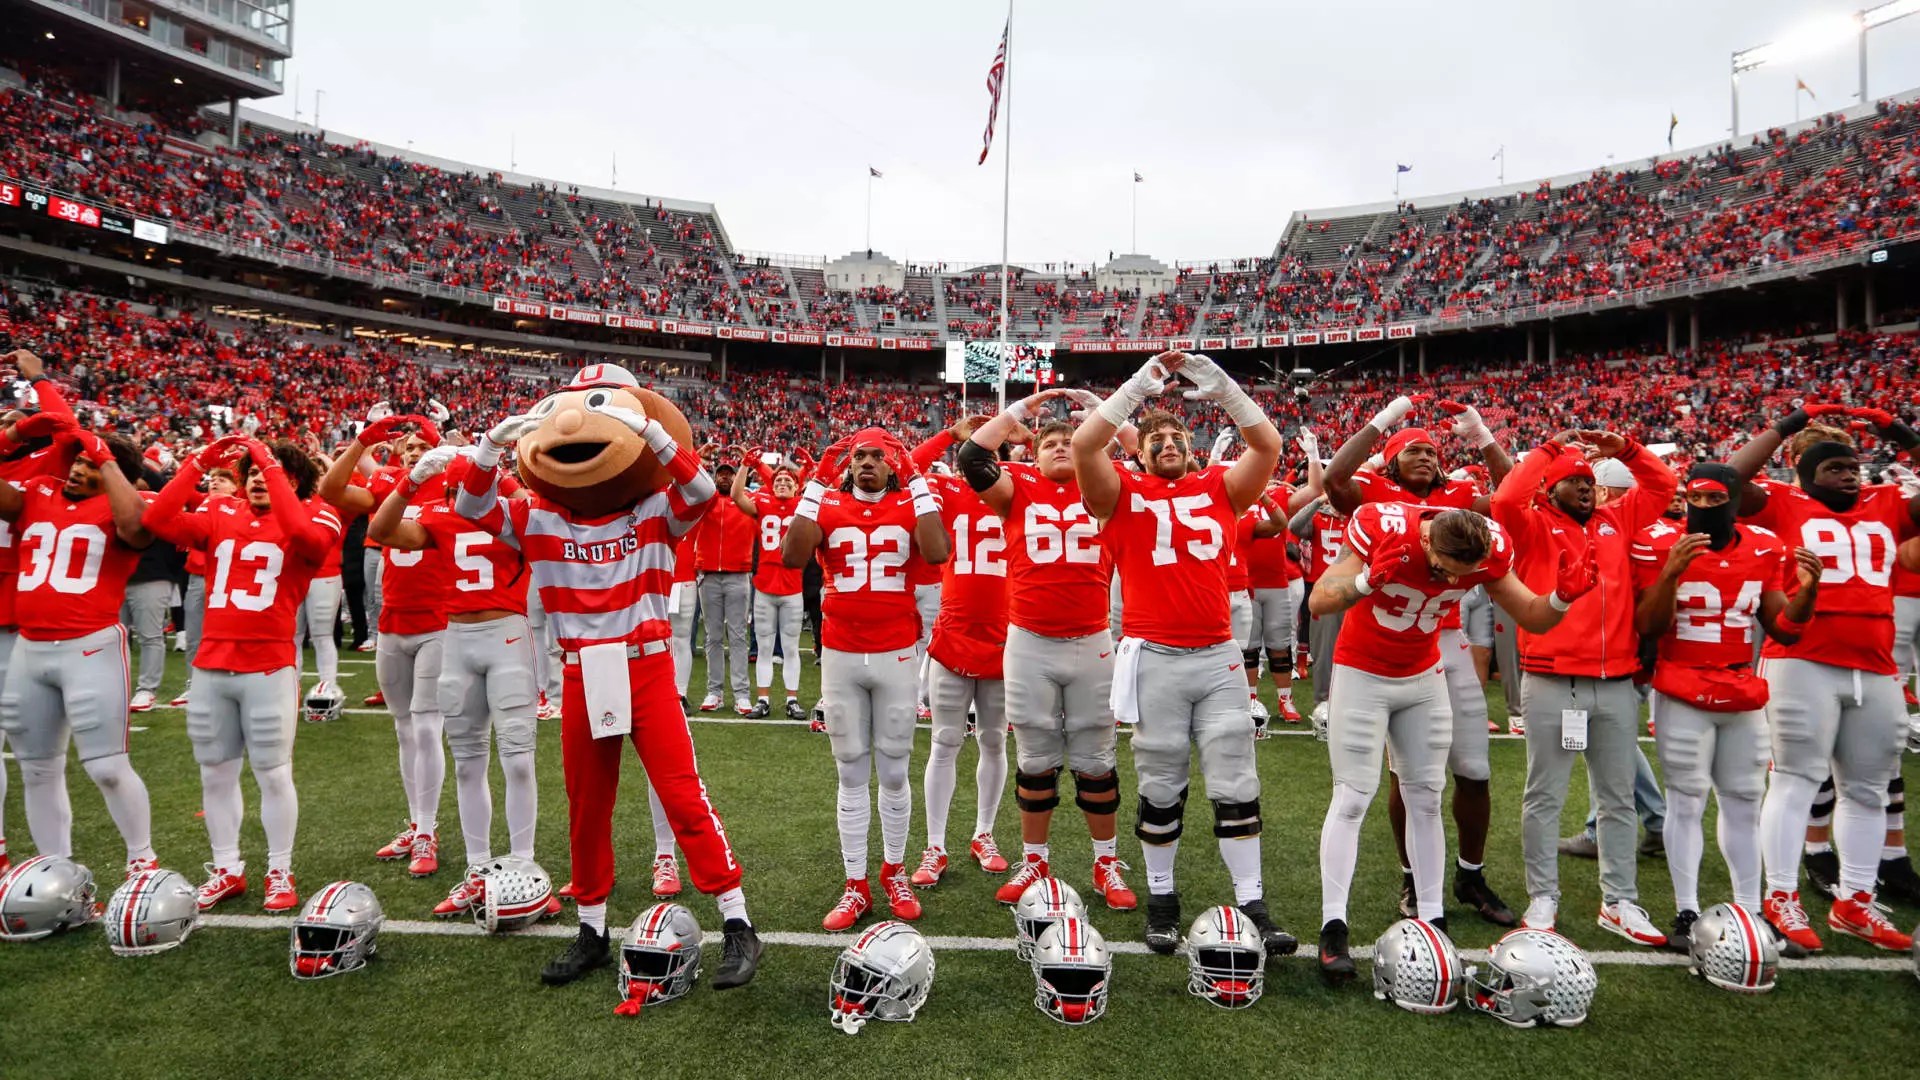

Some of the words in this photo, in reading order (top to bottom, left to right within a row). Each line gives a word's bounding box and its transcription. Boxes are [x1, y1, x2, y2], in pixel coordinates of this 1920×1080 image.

[58, 201, 79, 219] 38
[514, 303, 541, 316] SMITH
[625, 319, 654, 330] GEORGE
[1390, 327, 1413, 338] 2014
[788, 333, 819, 344] GRIFFIN
[844, 337, 874, 347] HARLEY
[900, 340, 928, 349] WILLIS
[1073, 342, 1112, 351] NATIONAL
[1116, 342, 1163, 351] CHAMPIONS
[17, 521, 107, 595] 30
[563, 530, 638, 562] BRUTUS
[952, 513, 1008, 578] 12
[1024, 502, 1102, 565] 62
[1131, 492, 1223, 567] 75
[1801, 518, 1897, 588] 90
[208, 539, 285, 612] 13
[454, 530, 494, 592] 5
[828, 525, 911, 593] 32
[1371, 583, 1468, 635] 36
[1676, 580, 1763, 644] 24
[698, 777, 737, 871] STATE
